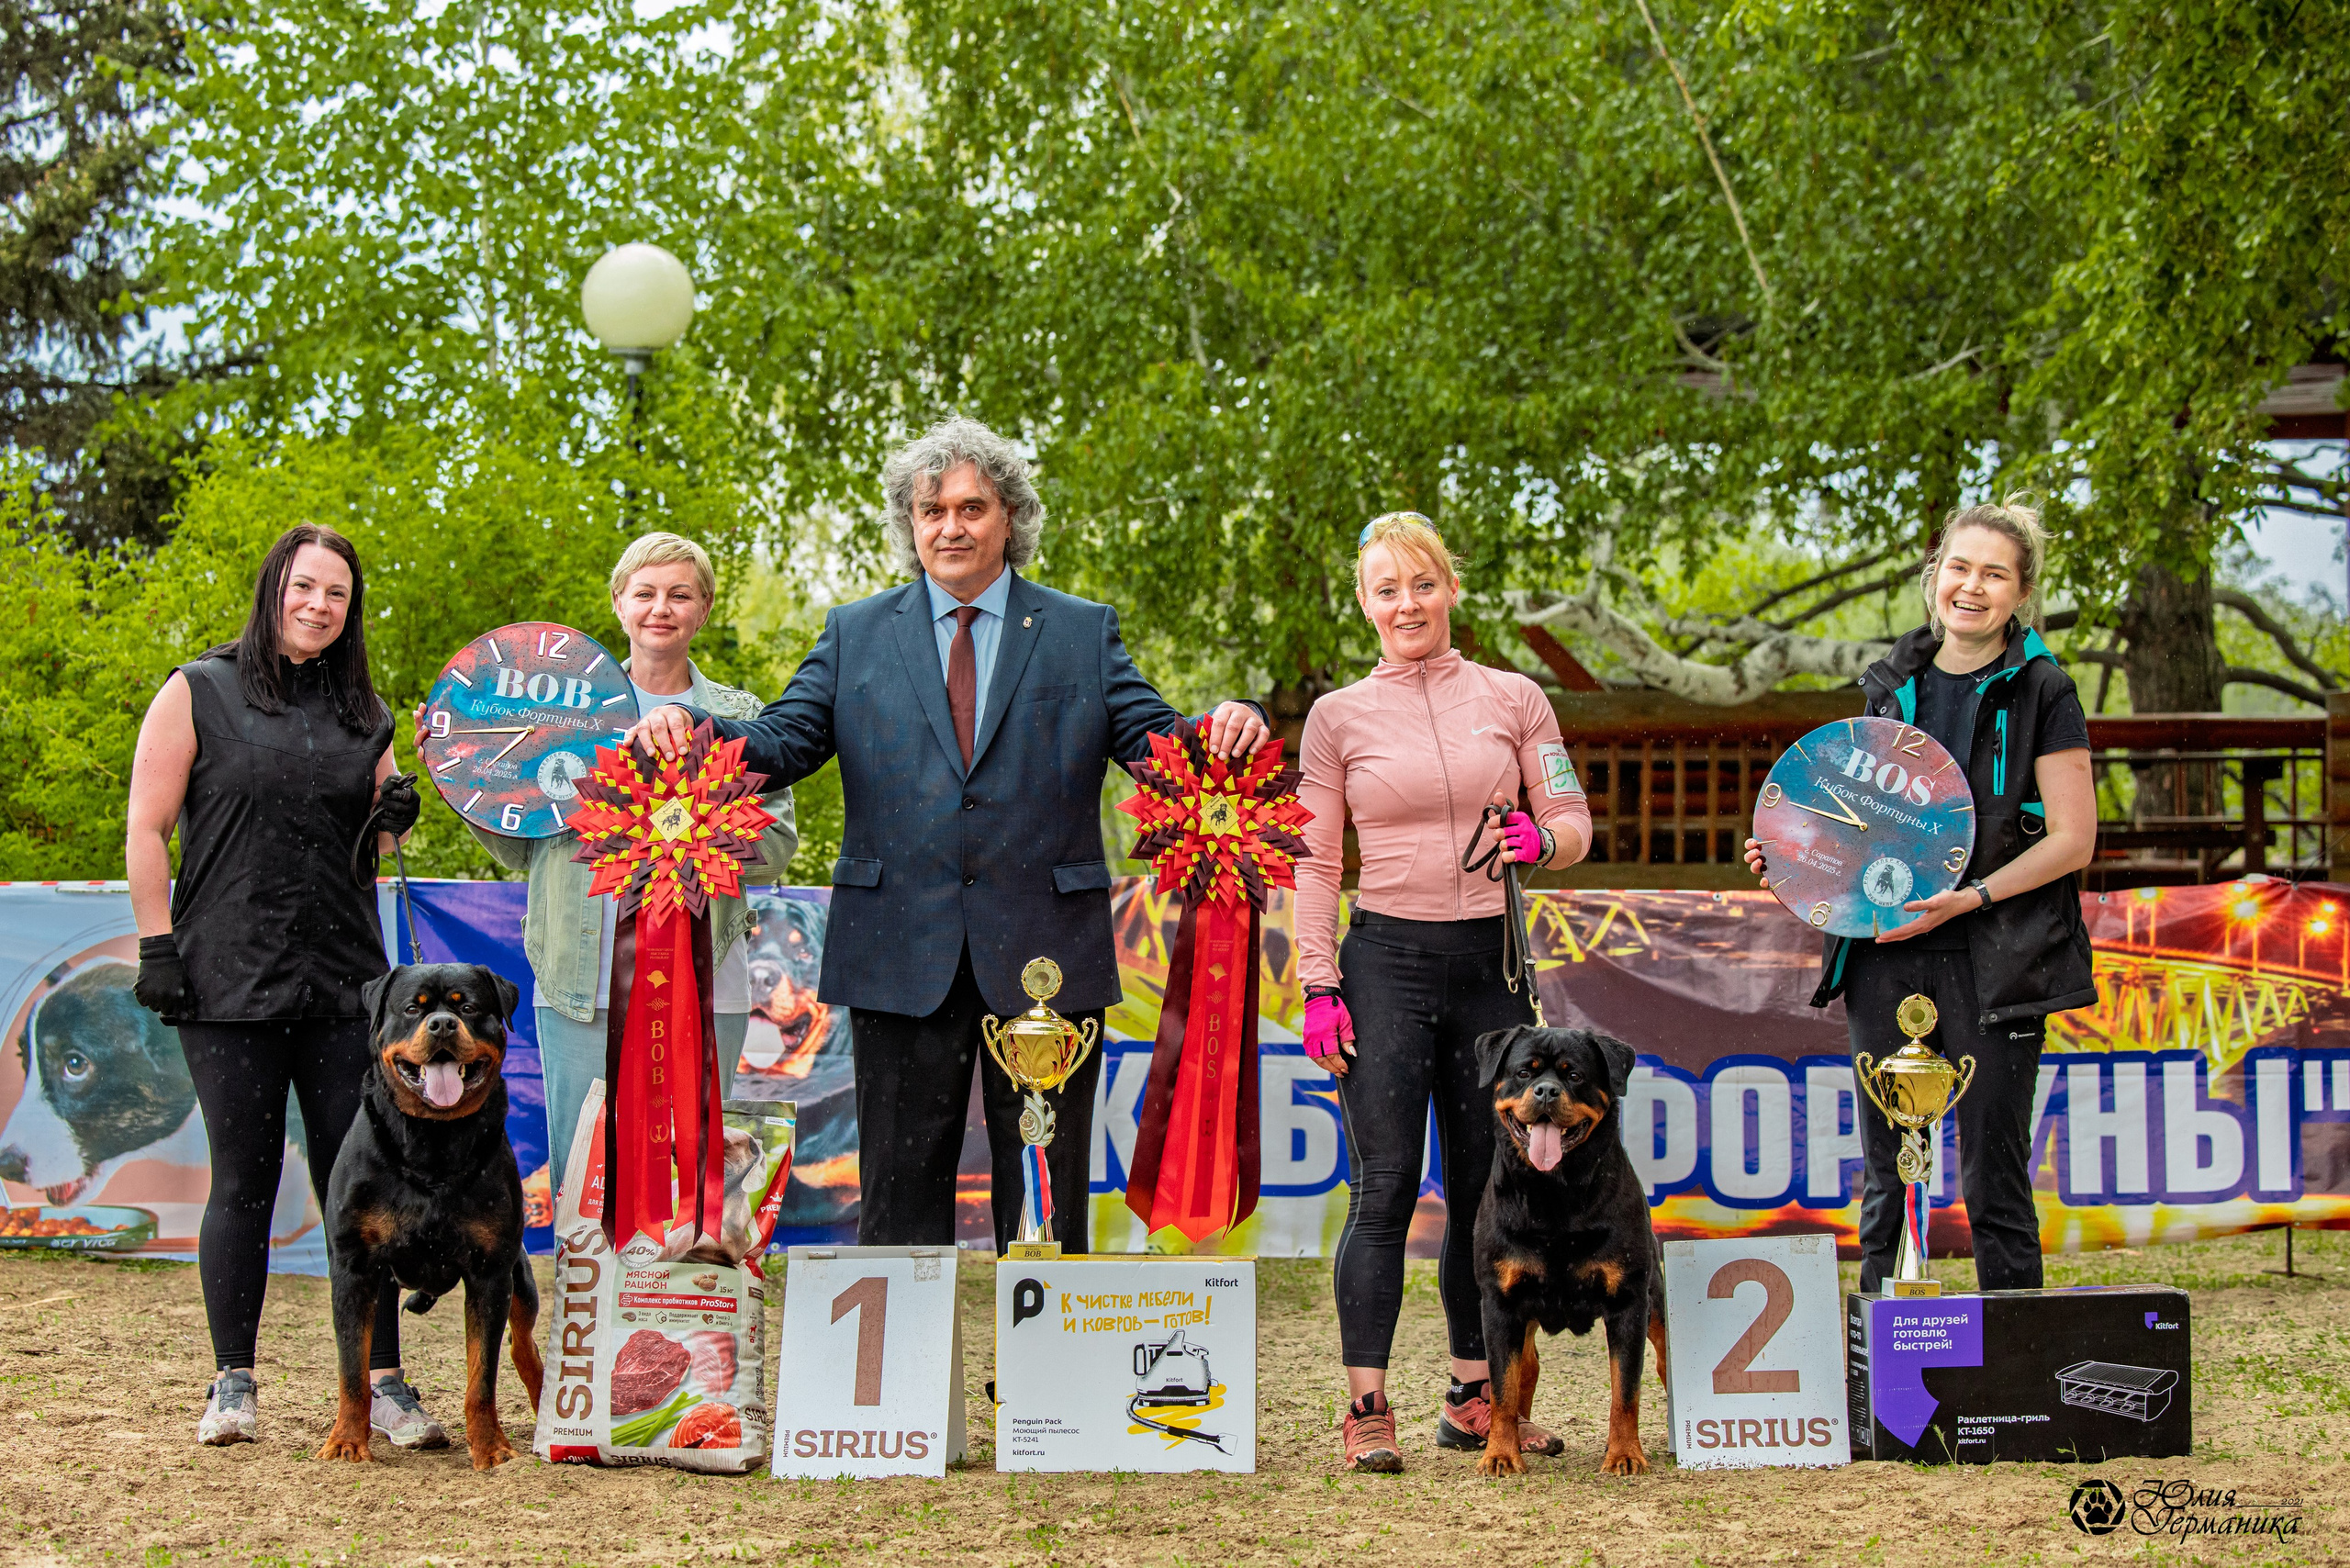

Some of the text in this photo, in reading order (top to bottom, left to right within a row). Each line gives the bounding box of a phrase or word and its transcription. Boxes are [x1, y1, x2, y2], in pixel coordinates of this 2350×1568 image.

[537, 631, 570, 659] 12
[492, 666, 592, 709] BOB
[470, 699, 515, 716] Кубок
[518, 707, 588, 729] Фортуны
[430, 711, 451, 738] 9
[1892, 724, 1927, 759] 12
[473, 765, 512, 778] 26.04.2025
[485, 758, 518, 770] Сратов
[1840, 746, 1936, 806] BOS
[1762, 783, 1782, 808] 9
[1814, 776, 1858, 801] Кубок
[1860, 795, 1927, 830] Фортуны
[500, 803, 523, 831] 6
[1796, 854, 1837, 874] 26.04.2025
[1811, 848, 1843, 866] Саратов
[1943, 846, 1966, 873] 3
[1809, 902, 1831, 926] 6
[650, 1020, 666, 1085] BOB
[1205, 1014, 1221, 1079] BOS
[626, 1246, 655, 1257] 40%
[626, 1270, 670, 1279] МЯСНОЙ
[1205, 1278, 1238, 1287] Kitfort
[624, 1281, 667, 1289] РАЦИОН
[633, 1295, 734, 1308] Комплекс пробиотиков ProStor+
[1061, 1293, 1072, 1313] К
[669, 1312, 699, 1320] Поддерживает
[1064, 1317, 1076, 1333] И
[1893, 1314, 1968, 1327] Для друзей
[1707, 1259, 1800, 1394] 2
[1893, 1329, 1947, 1338] готовлю
[831, 1277, 889, 1406] 1
[1893, 1339, 1953, 1351] быстрей!
[1957, 1415, 2051, 1424] Раклетница-гриль
[554, 1428, 593, 1437] PREMIUM
[1013, 1427, 1046, 1435] Моющий
[1013, 1449, 1045, 1457] kitfort.ru
